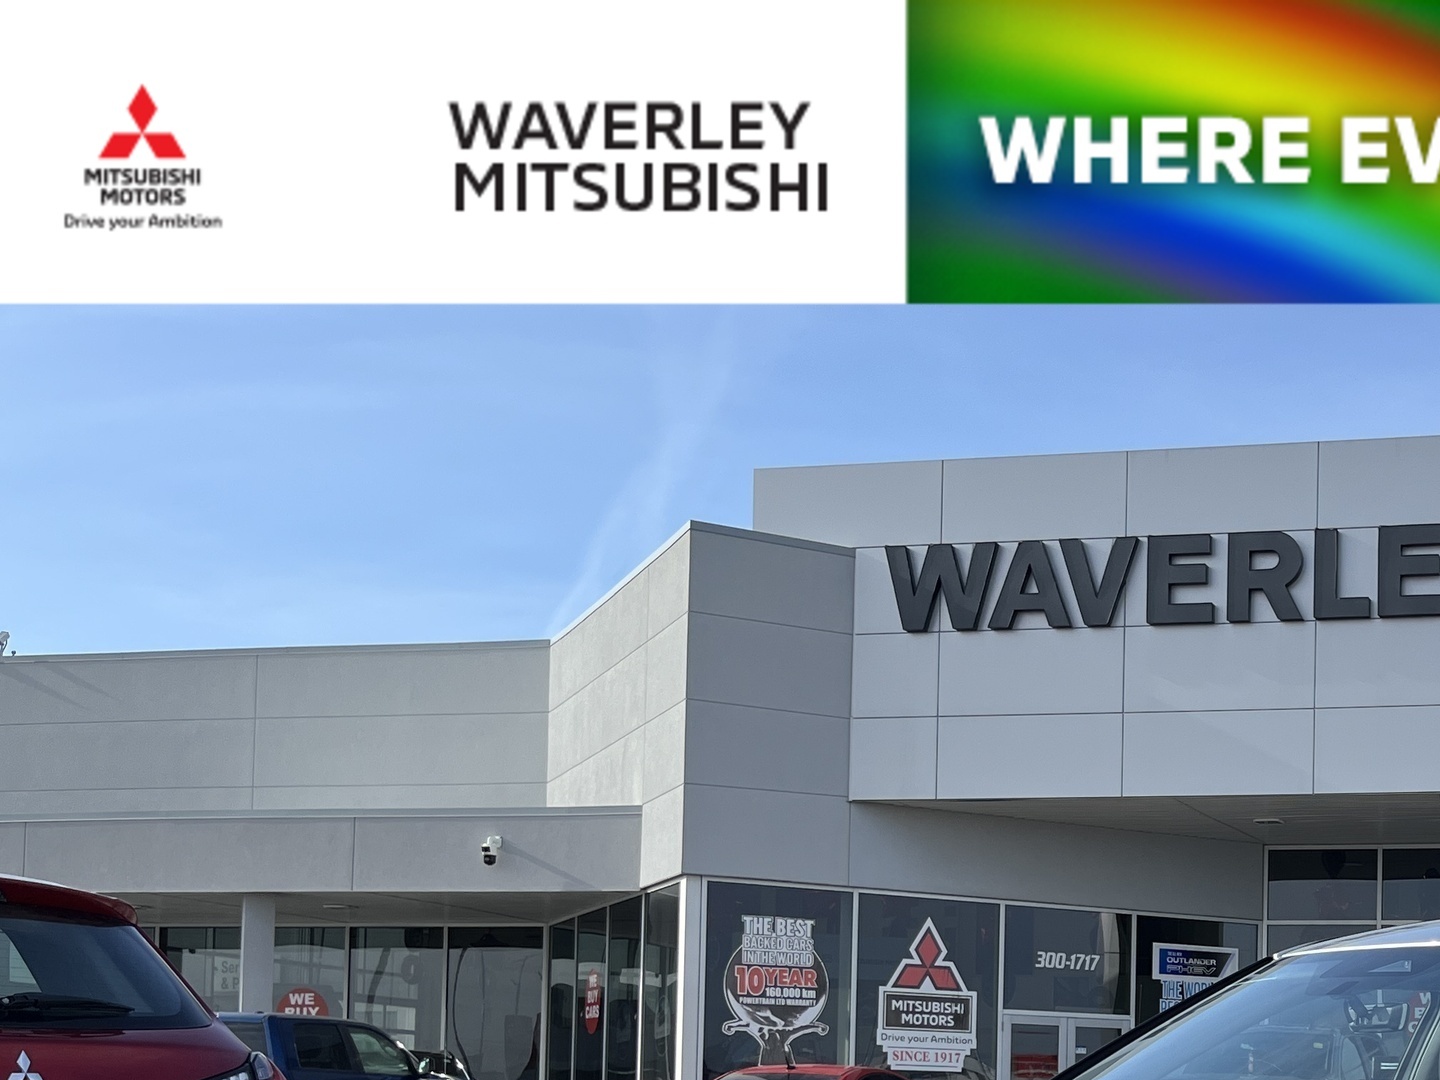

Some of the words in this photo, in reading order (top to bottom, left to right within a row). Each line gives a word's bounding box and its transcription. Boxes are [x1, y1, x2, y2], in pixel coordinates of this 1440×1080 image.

[743, 916, 773, 935] THE
[775, 918, 815, 938] BEST
[744, 937, 785, 950] BACKED
[786, 938, 814, 952] CARS
[744, 950, 754, 963] IN
[755, 951, 776, 964] THE
[777, 952, 814, 966] WORLD
[1035, 951, 1100, 971] 300-1717
[1166, 956, 1217, 966] OUTLANDER
[1166, 964, 1216, 975] PHEV
[735, 966, 765, 996] 10
[764, 967, 818, 988] YEAR
[587, 990, 599, 1003] BUY
[765, 987, 800, 998] 160,000
[801, 988, 816, 999] km
[1162, 981, 1182, 999] THE
[289, 993, 315, 1005] WE
[585, 1005, 600, 1019] CARS
[891, 999, 964, 1015] MITSUBISHI
[901, 1013, 955, 1027] MOTORS
[881, 1033, 906, 1041] Drive
[908, 1035, 929, 1044] your
[930, 1035, 973, 1045] Ambition
[892, 1050, 930, 1062] SINCE
[934, 1052, 961, 1063] 1917
